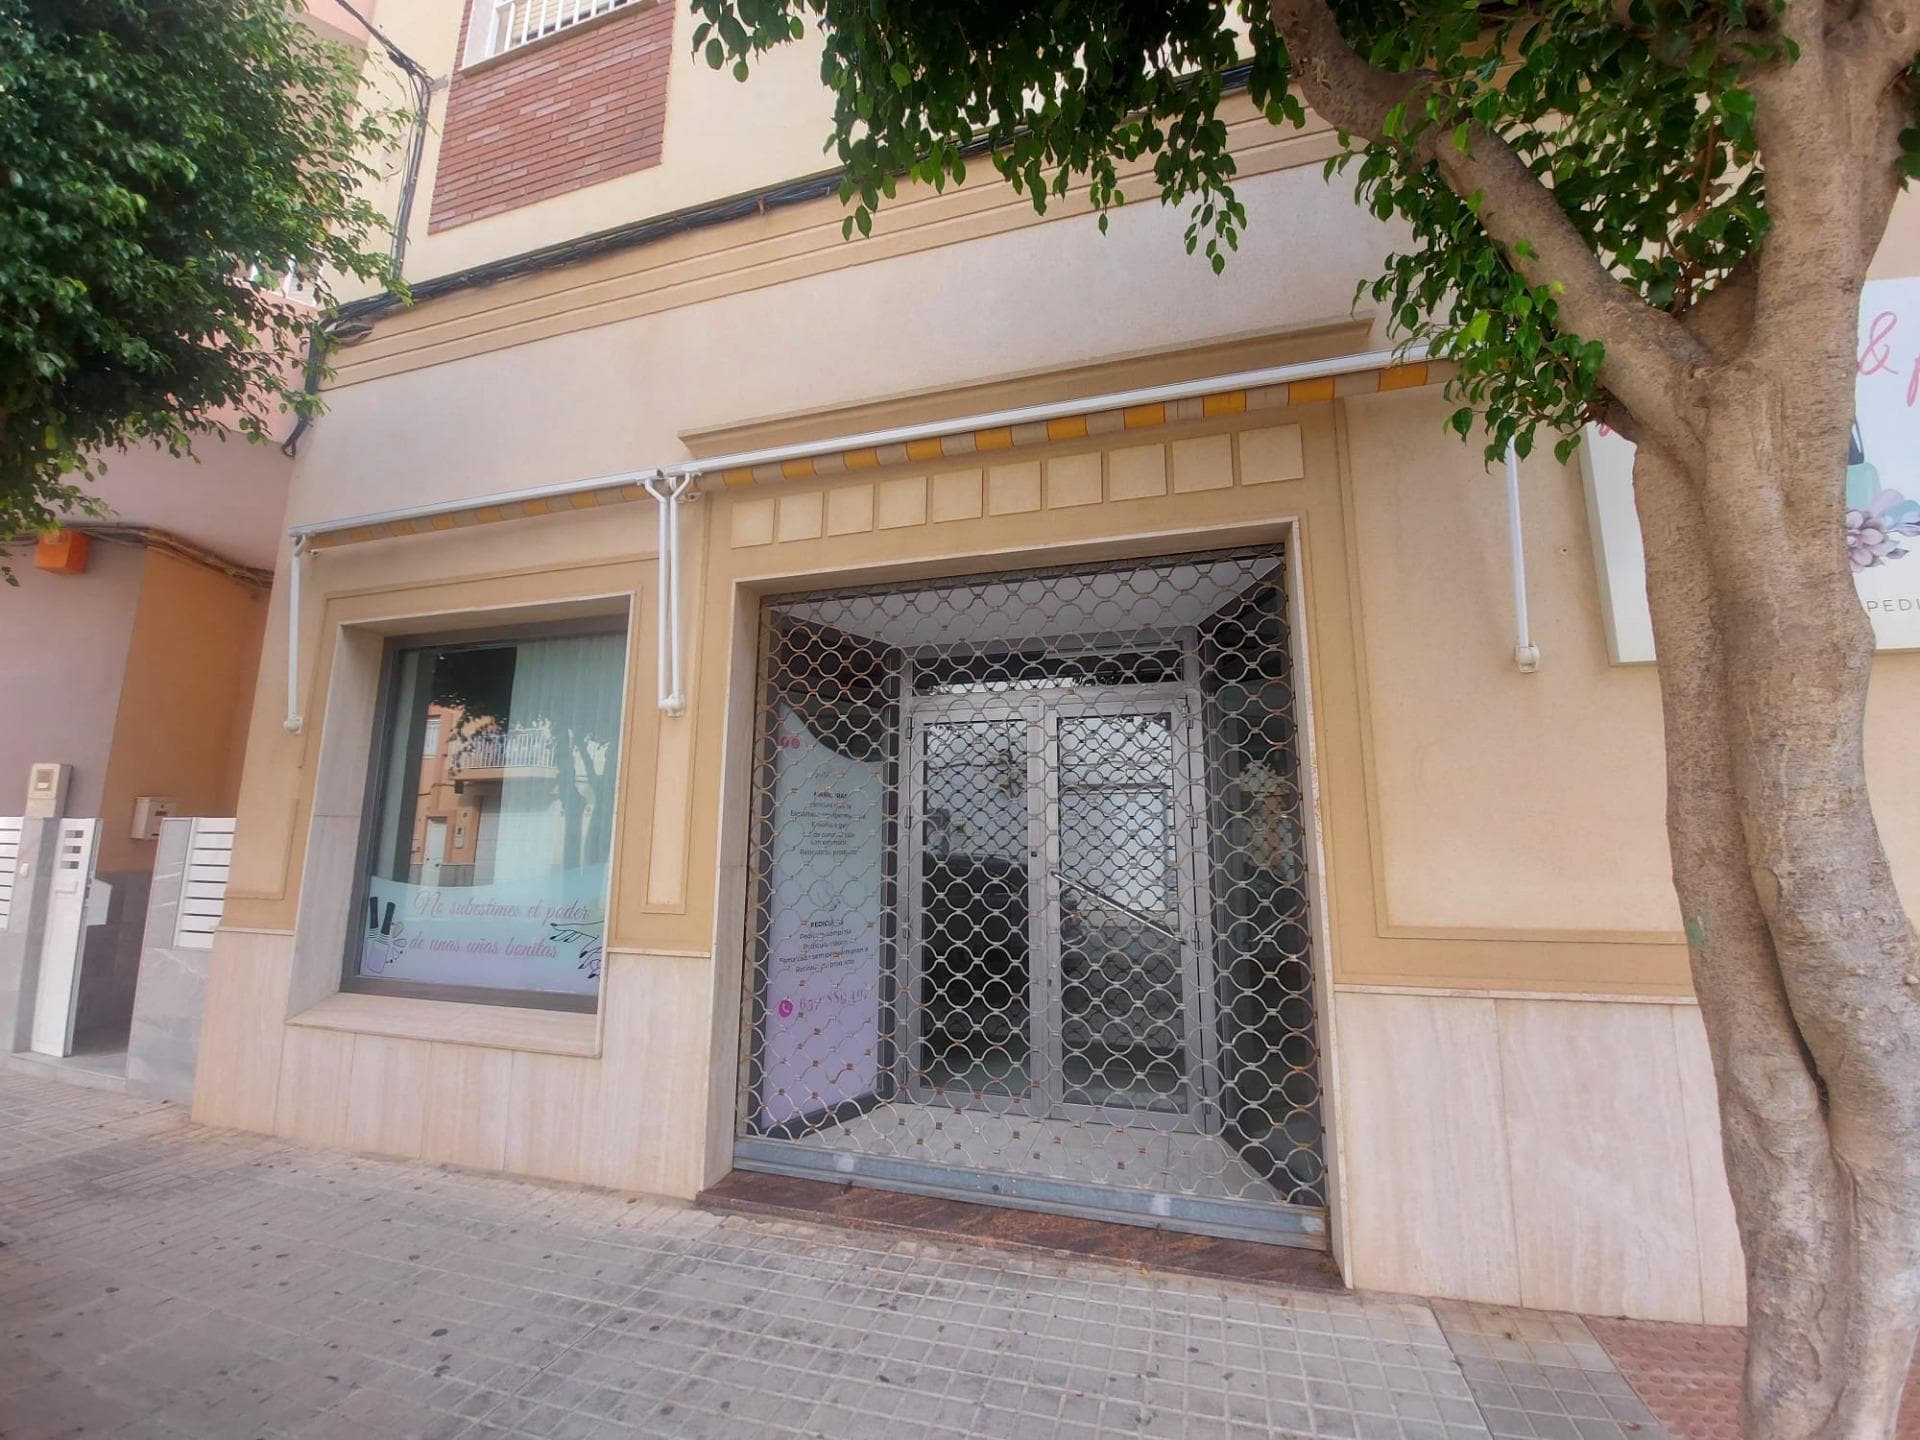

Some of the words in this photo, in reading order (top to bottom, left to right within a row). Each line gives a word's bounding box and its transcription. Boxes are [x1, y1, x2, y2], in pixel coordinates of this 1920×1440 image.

[414, 890, 443, 918] No
[451, 898, 520, 919] subestimes
[527, 900, 543, 919] el
[542, 900, 590, 926] poder
[408, 931, 423, 950] de
[429, 937, 460, 953] unas
[467, 938, 498, 956] uñas
[504, 936, 560, 959] bonitas
